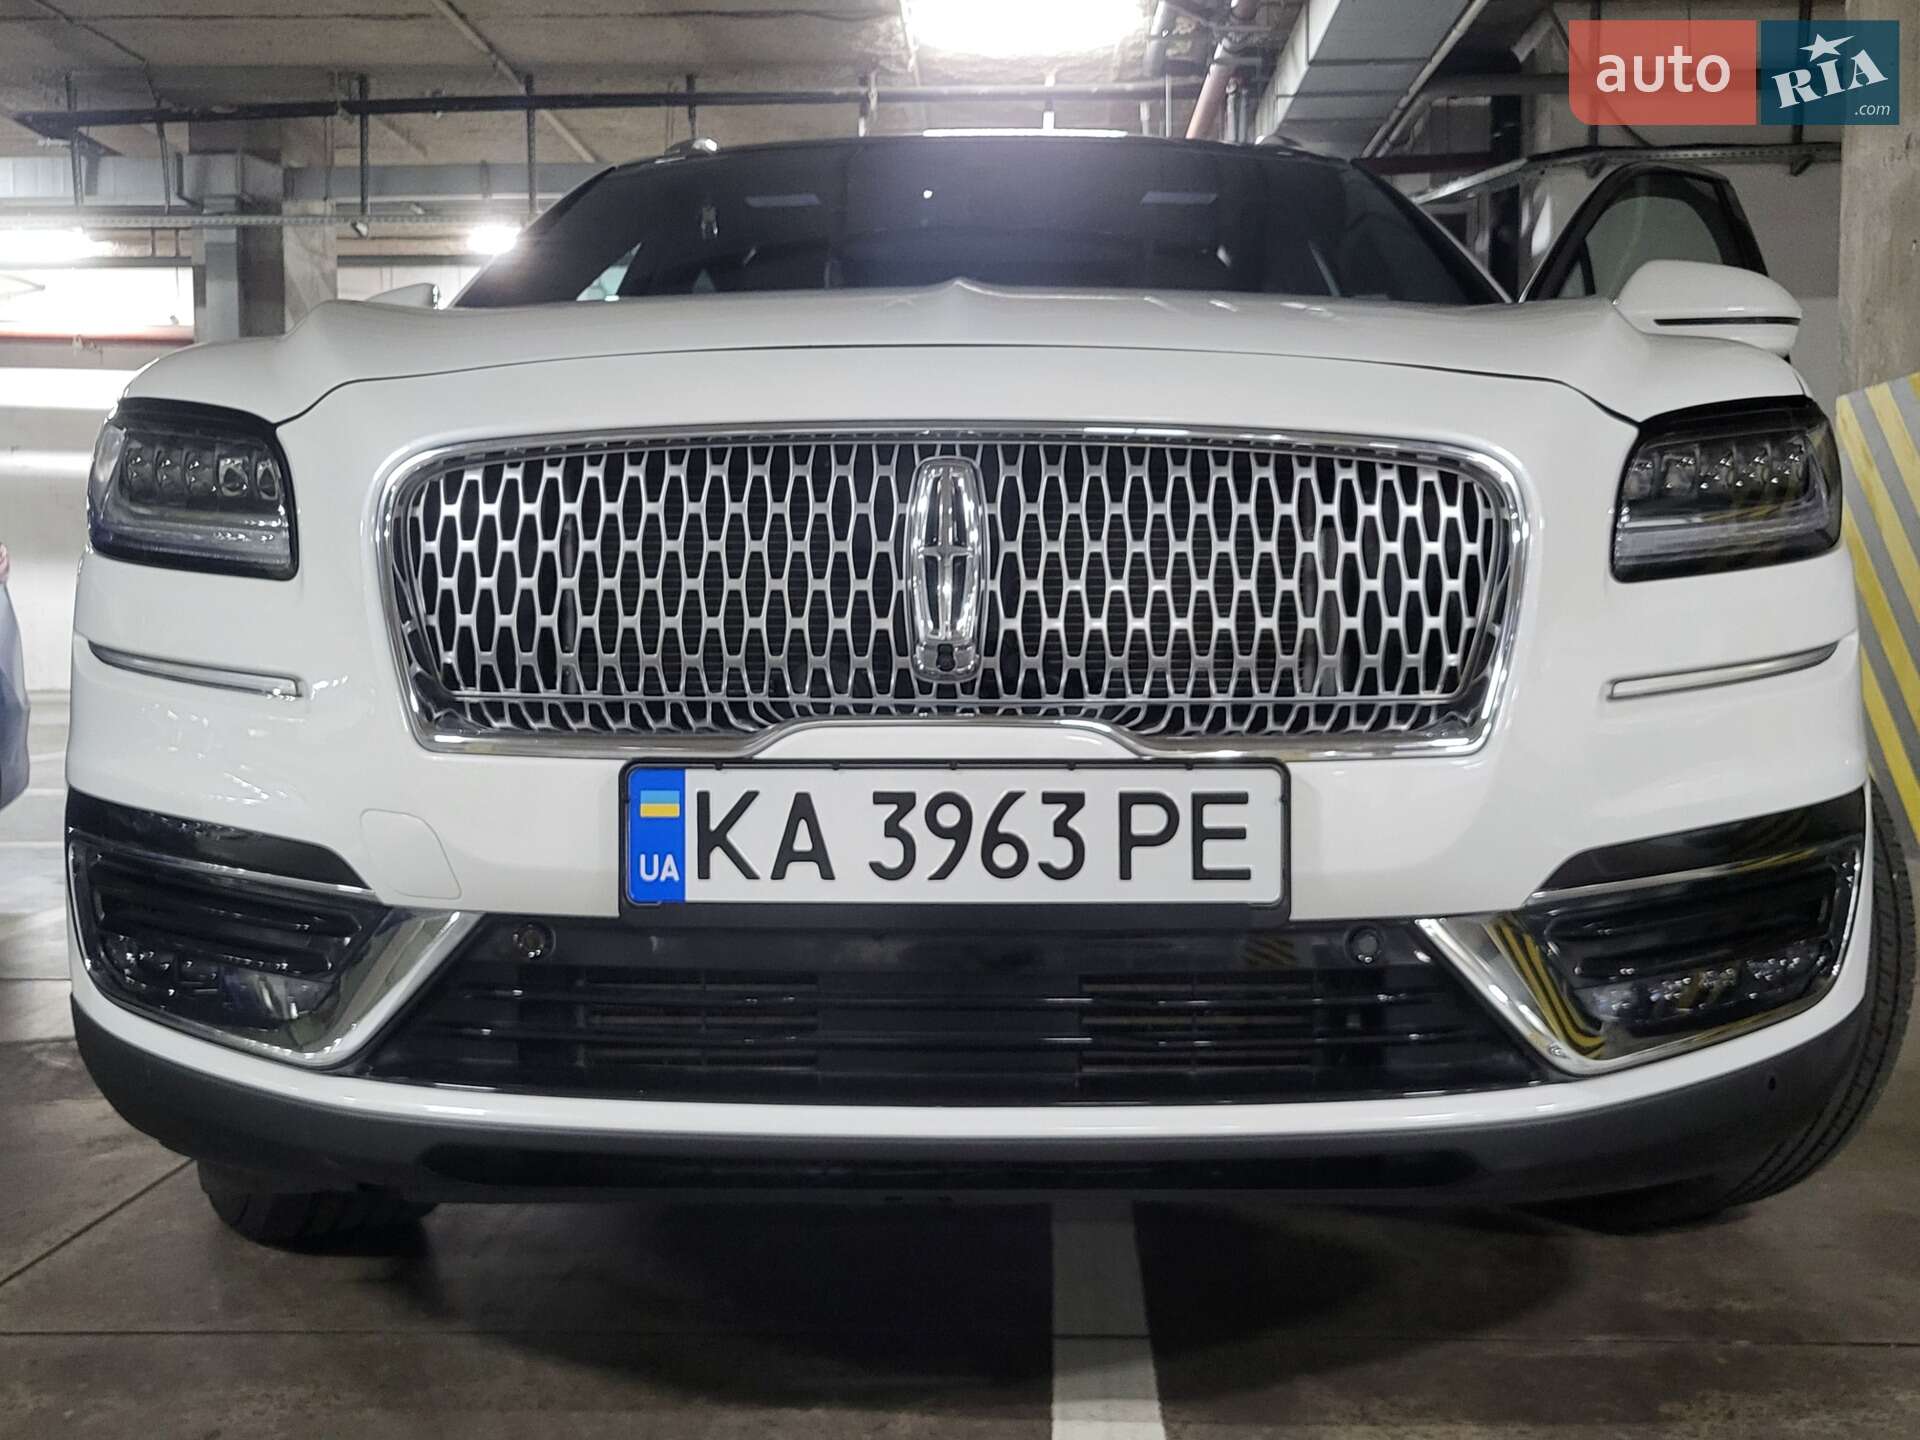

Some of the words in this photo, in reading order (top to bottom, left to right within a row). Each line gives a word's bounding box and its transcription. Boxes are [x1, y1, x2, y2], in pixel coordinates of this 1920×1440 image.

[697, 790, 835, 881] KA
[868, 790, 1086, 881] 3963
[1118, 790, 1252, 881] PE
[639, 853, 680, 882] UA
